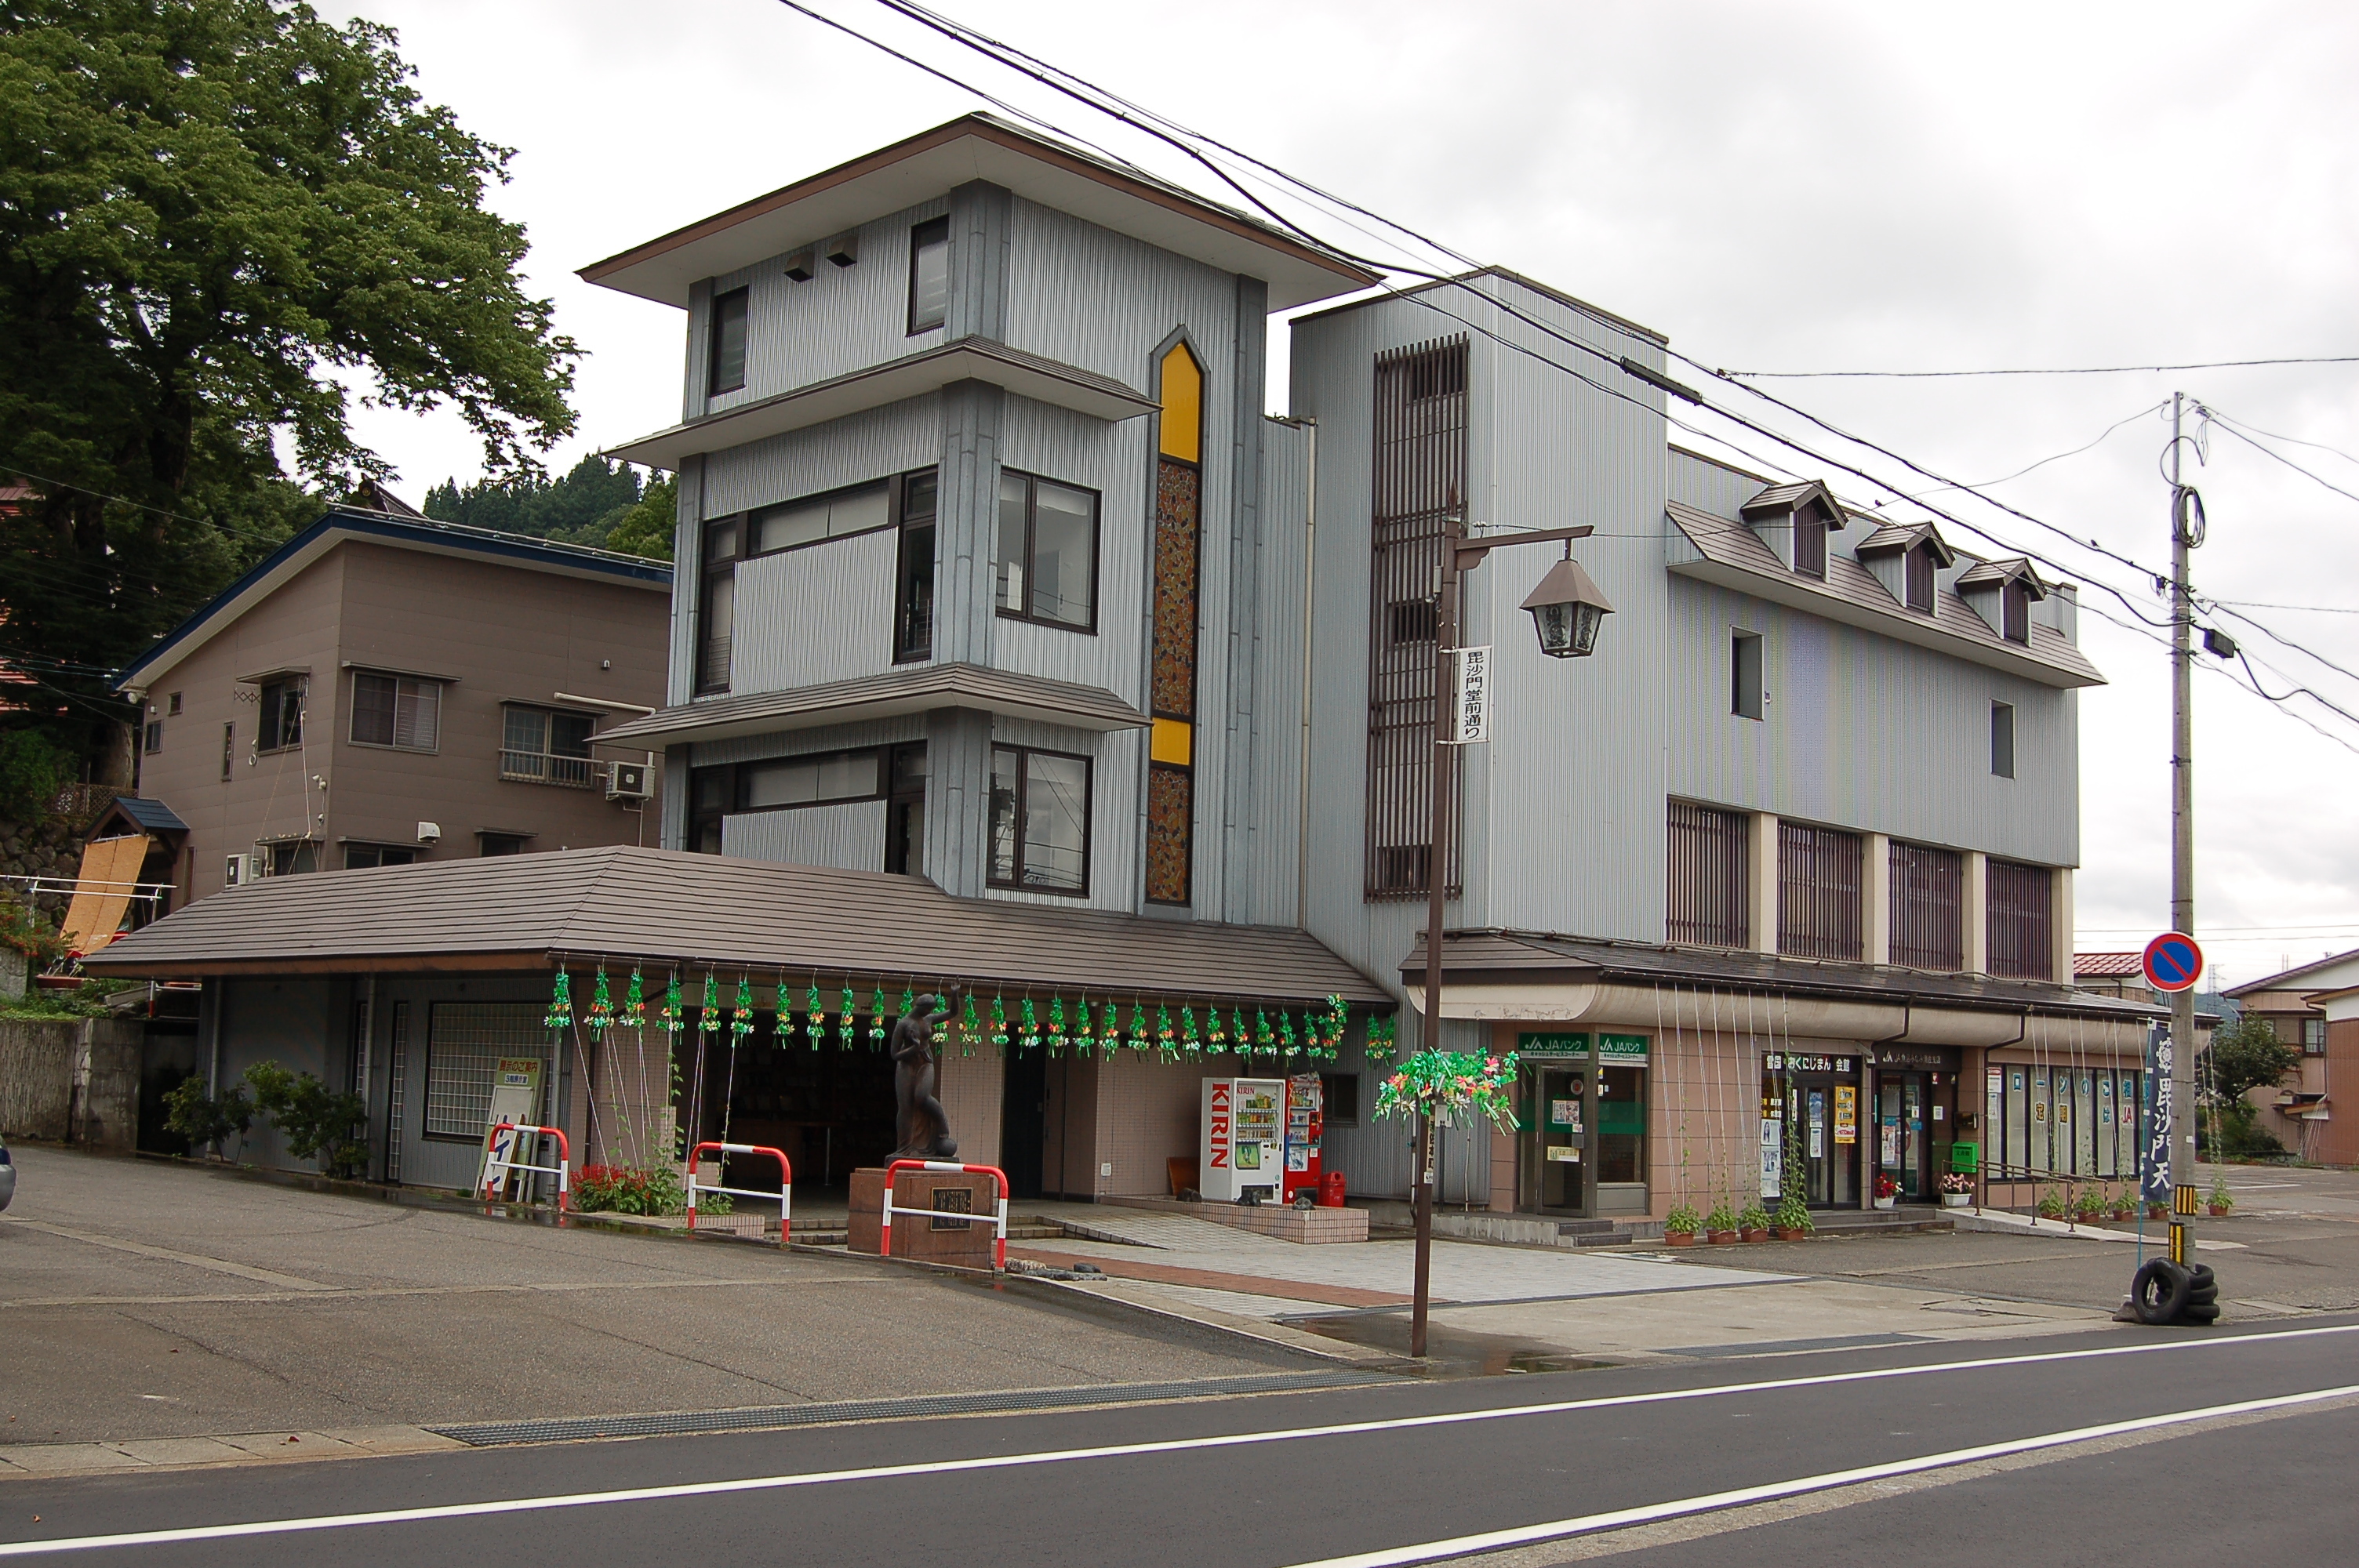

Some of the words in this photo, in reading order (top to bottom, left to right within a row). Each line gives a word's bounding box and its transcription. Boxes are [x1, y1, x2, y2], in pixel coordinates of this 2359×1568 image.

[1464, 651, 1484, 739] 毘沙門堂前通り
[1545, 1040, 1582, 1051] JAバンク
[1614, 1041, 1640, 1052] JAバンク
[500, 1060, 538, 1073] 展示のご案内
[1788, 1056, 1831, 1071] おくにじまん
[1836, 1058, 1850, 1073] 会館
[1237, 1087, 1255, 1095] KIRIN
[1210, 1082, 1230, 1169] KIRIN
